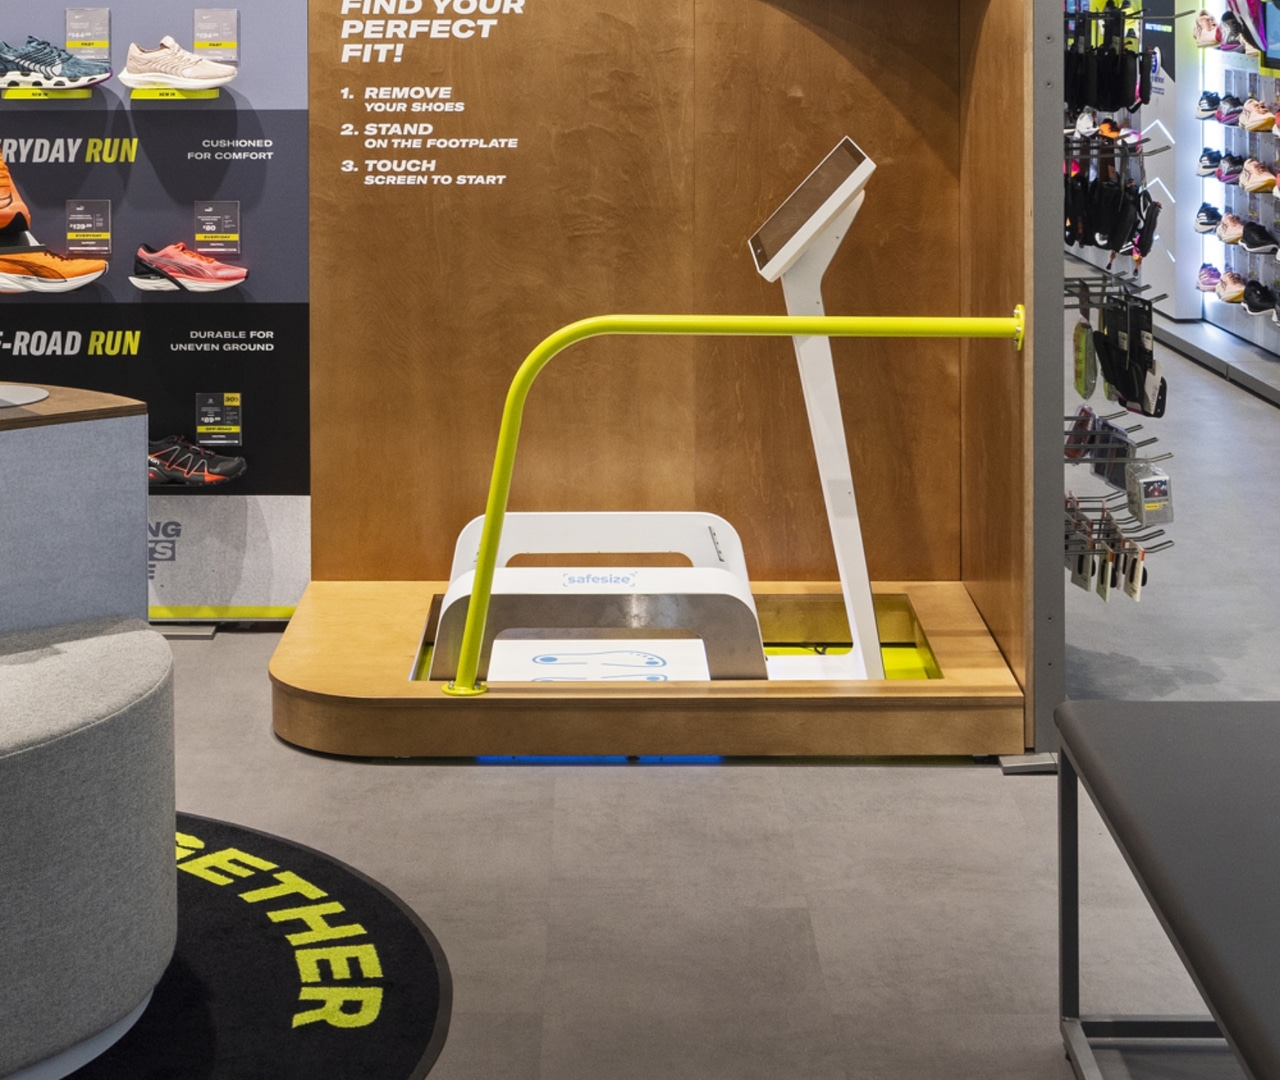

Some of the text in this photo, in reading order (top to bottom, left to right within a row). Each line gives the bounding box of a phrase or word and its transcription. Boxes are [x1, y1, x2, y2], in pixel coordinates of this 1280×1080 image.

[340, 19, 498, 39] PERFECT
[340, 43, 404, 63] FIT!
[340, 87, 452, 99] 1. REMOVE
[364, 102, 465, 112] YOUR SHOES
[340, 123, 434, 135] 2. STAND
[202, 139, 274, 148] CUSHIONED
[364, 138, 519, 148] ON THE FOOTPLATE
[85, 138, 138, 164] RUN
[187, 151, 274, 161] FOR COMFORT
[341, 160, 436, 172] 3. TOUCH
[364, 175, 506, 185] SCREEN TO START
[190, 330, 274, 339] DURABLE FOR
[87, 331, 141, 357] RUN
[170, 343, 275, 352] UNEVEN GROUND
[567, 573, 631, 585] safesize
